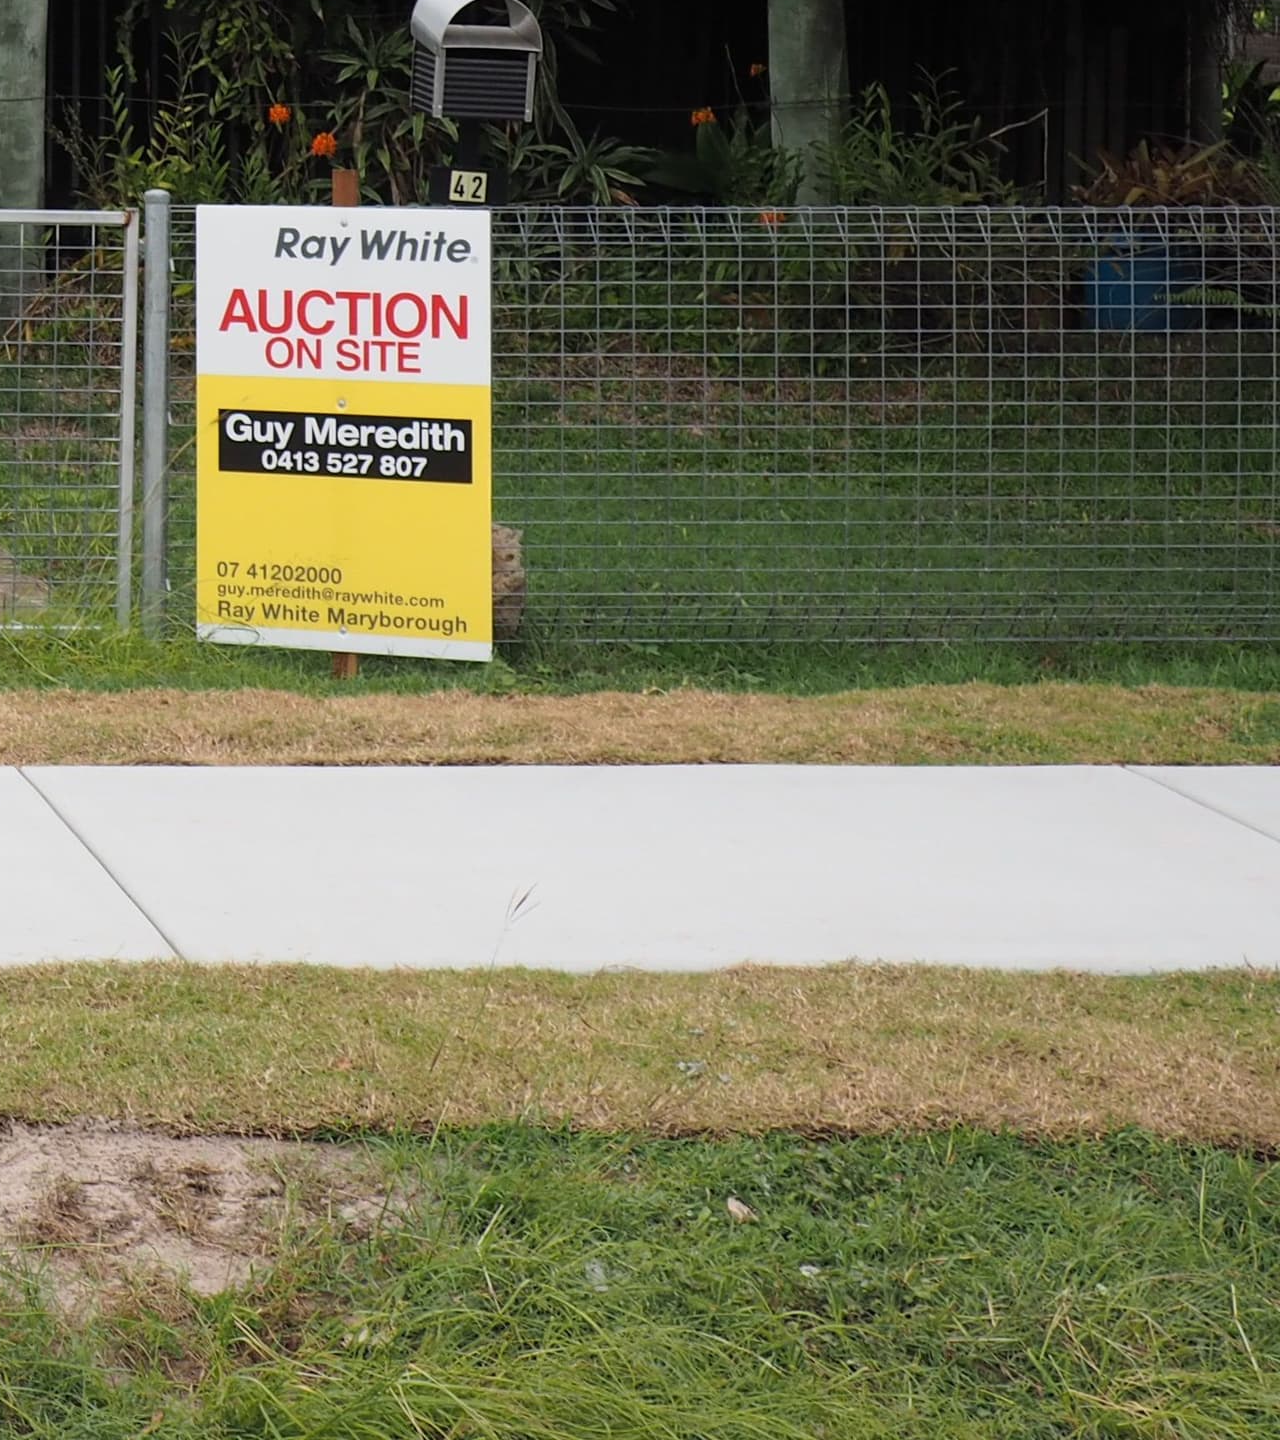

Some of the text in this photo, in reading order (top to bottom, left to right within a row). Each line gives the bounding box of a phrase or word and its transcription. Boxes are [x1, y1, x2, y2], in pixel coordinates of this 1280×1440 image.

[452, 173, 484, 199] 42
[274, 227, 472, 266] Ray White
[218, 288, 469, 340] AUCTION
[265, 336, 422, 373] ON SITE
[225, 412, 466, 452] Guy Meredith
[261, 449, 428, 478] 0413 527 807
[216, 561, 343, 585] 07 41202000
[217, 583, 445, 609] guy.meredith@raywhite.com
[217, 599, 468, 637] Ray White Maryborough
